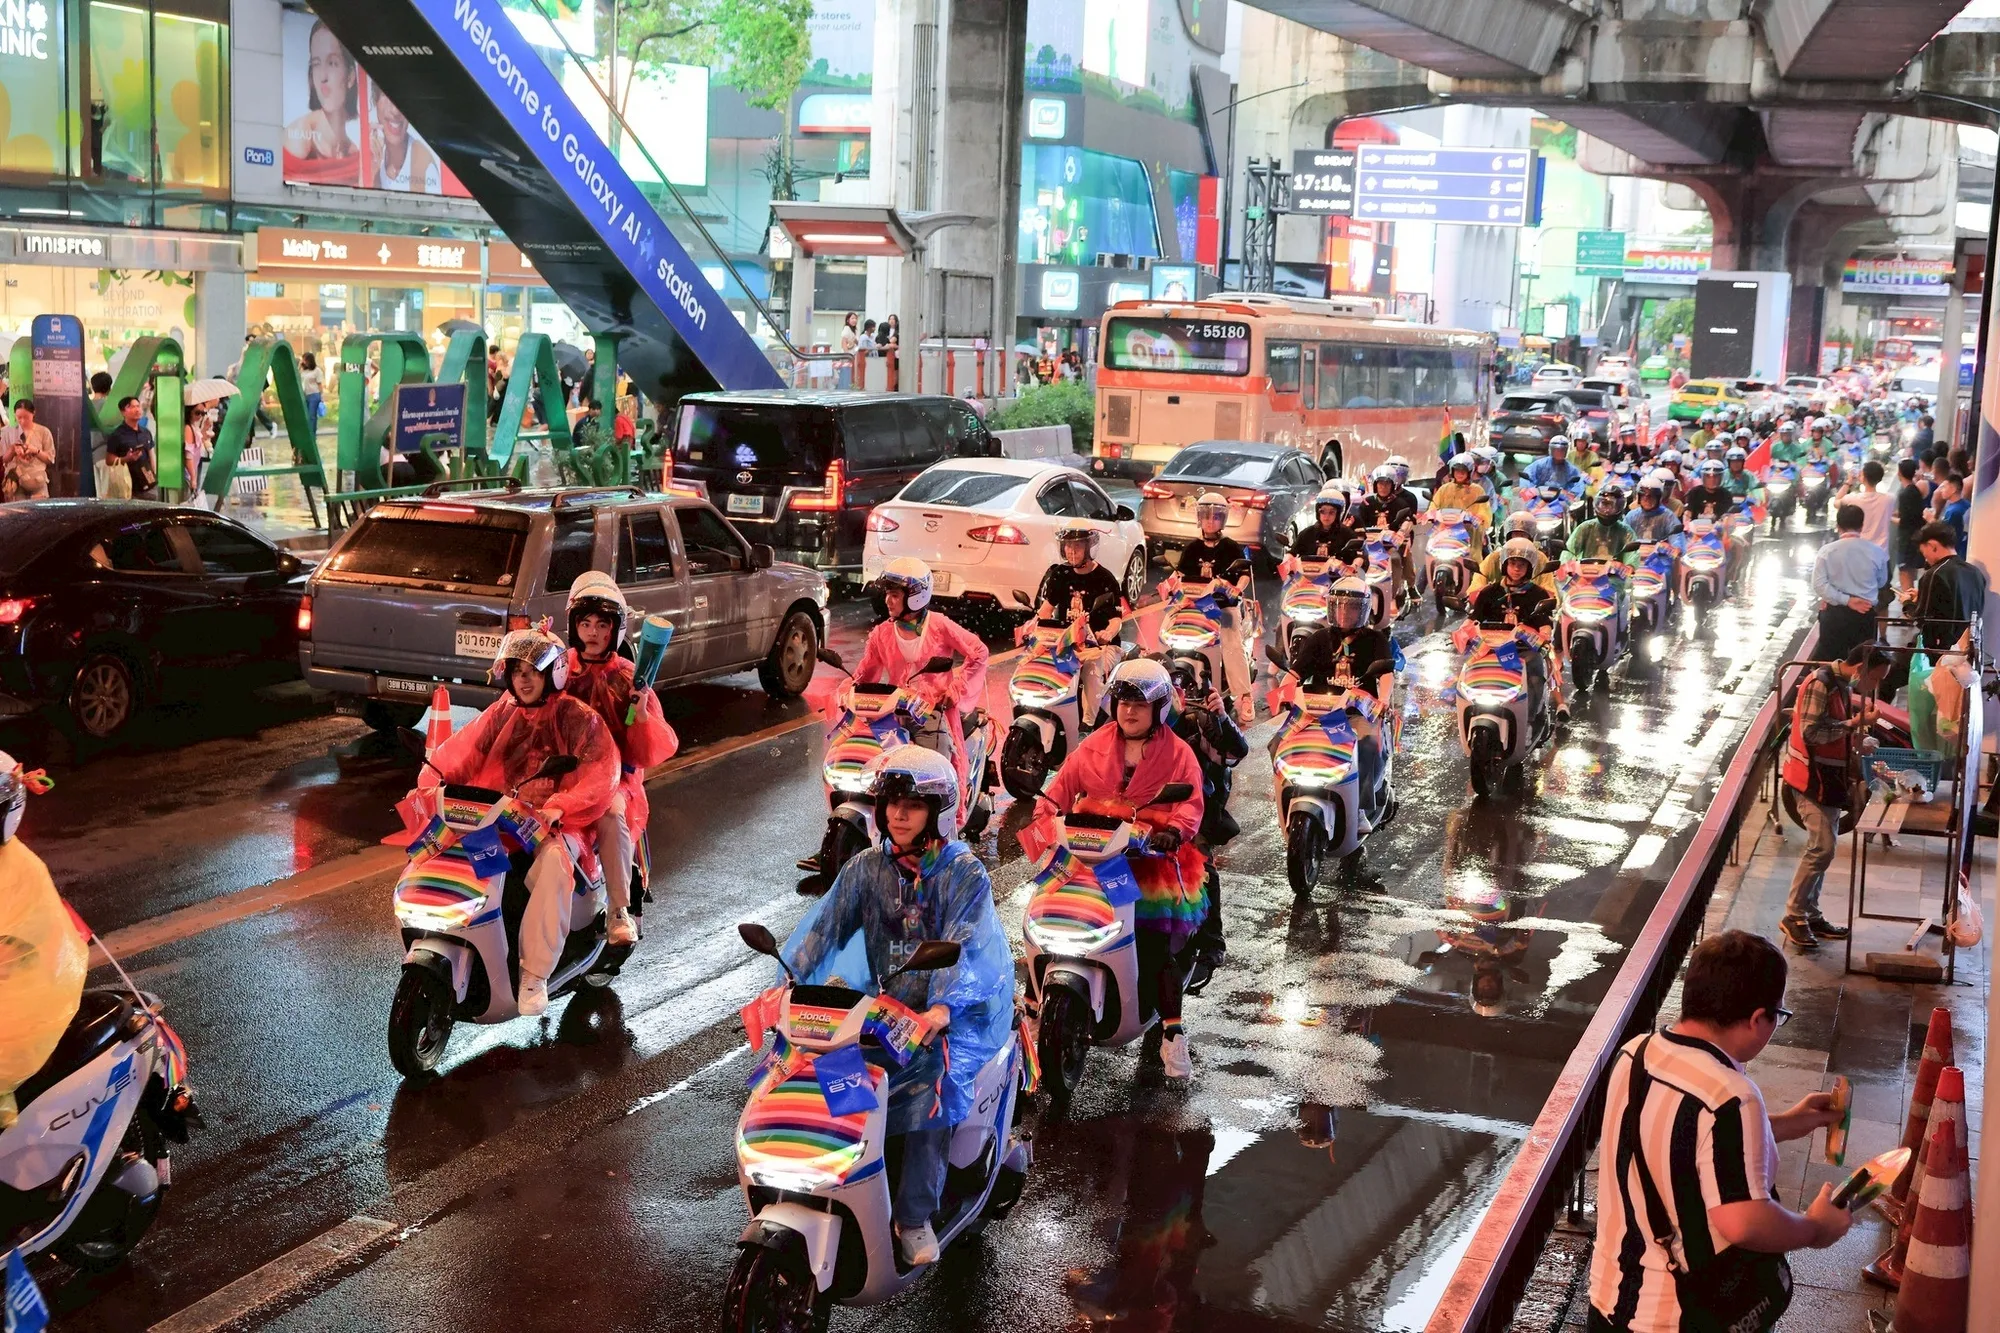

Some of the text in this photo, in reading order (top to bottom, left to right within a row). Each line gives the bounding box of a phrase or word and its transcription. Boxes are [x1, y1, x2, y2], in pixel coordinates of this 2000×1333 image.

[821, 12, 851, 21] stores
[362, 44, 434, 57] SAMSUNG
[453, 0, 708, 331] Welcome to Galaxy AI station
[1492, 156, 1502, 171] 6
[1490, 180, 1501, 195] 5
[282, 238, 348, 261] Molly Tea
[1642, 254, 1698, 271] BORN
[1854, 269, 1916, 285] RIGHT
[103, 305, 162, 317] HYDRATION
[479, 636, 502, 649] 6796
[416, 682, 428, 693] BKK
[452, 803, 480, 813] Honda
[449, 812, 463, 821] Pride
[1074, 831, 1102, 840] Honda
[799, 1011, 832, 1024] Honda
[796, 1024, 829, 1034] Pride Ride
[827, 1071, 862, 1087] Honda
